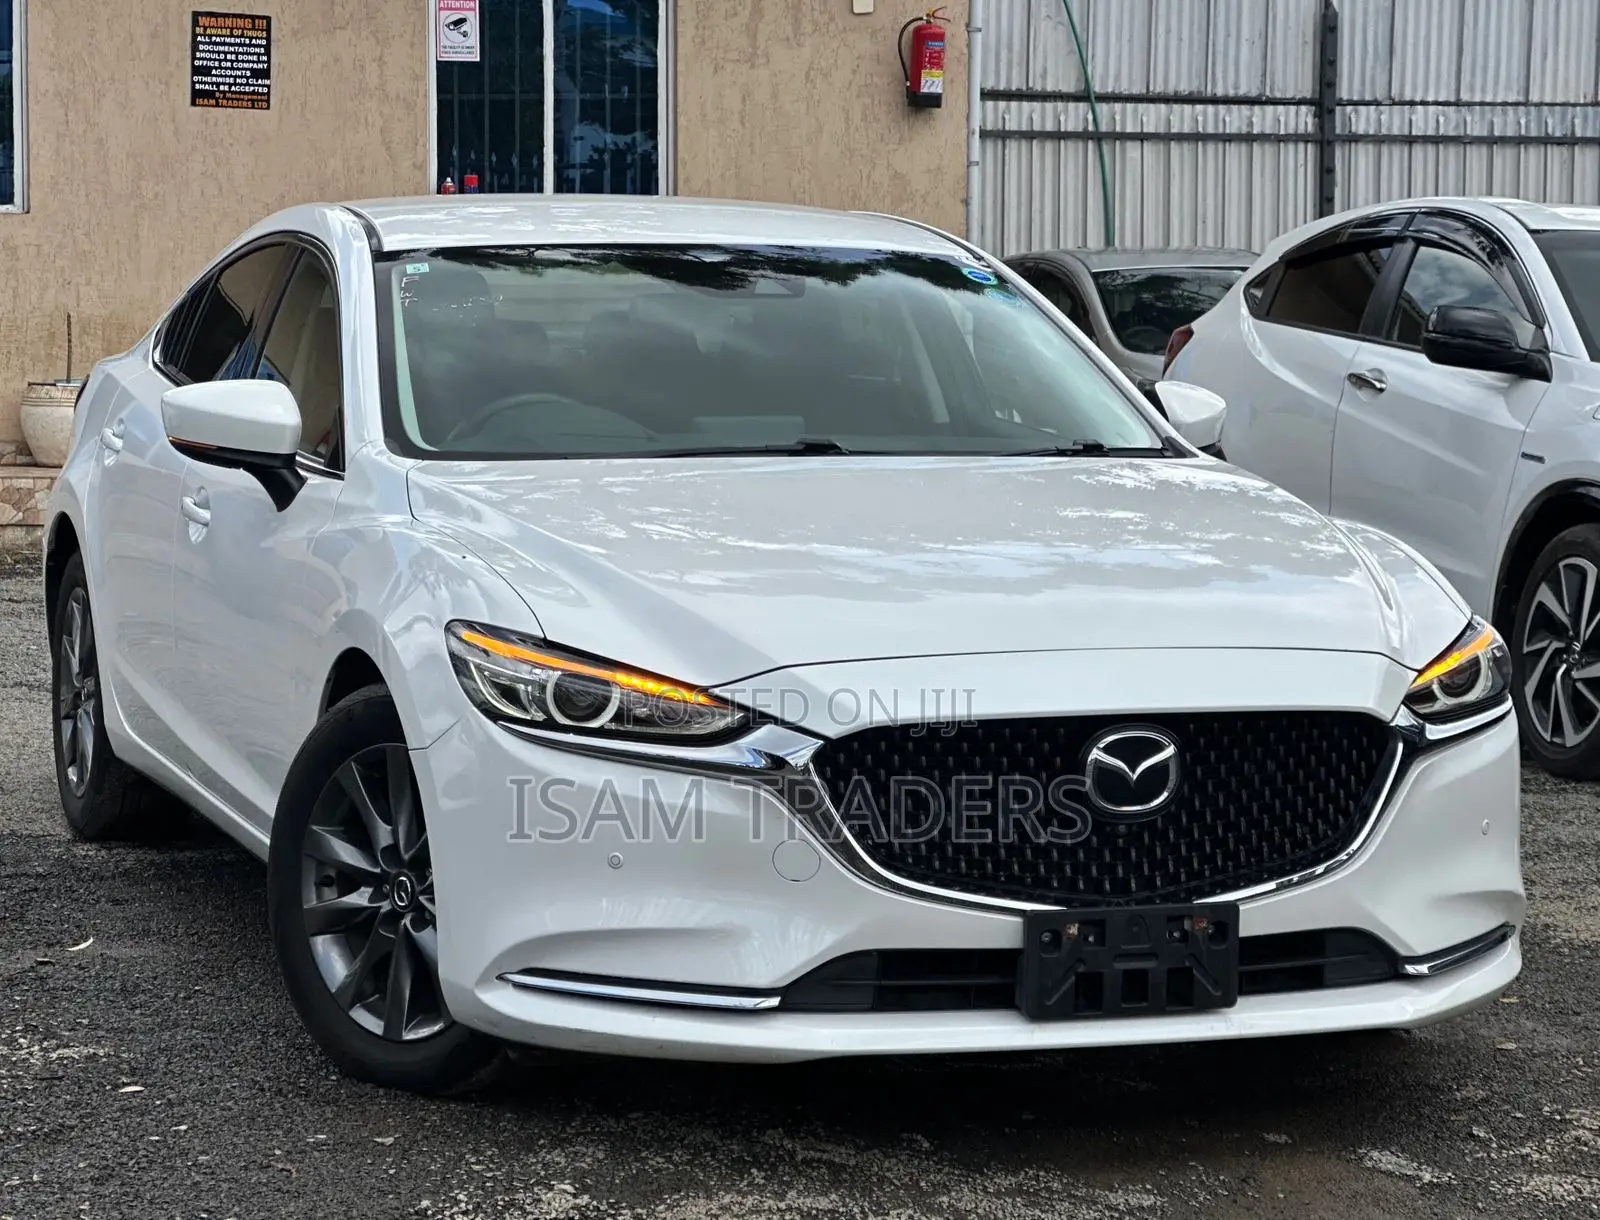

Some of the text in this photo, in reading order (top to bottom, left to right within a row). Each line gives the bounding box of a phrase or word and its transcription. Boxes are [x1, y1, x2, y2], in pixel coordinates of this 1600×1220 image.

[439, 0, 475, 8] ATTENTION
[199, 16, 266, 29] WARNING !!!
[199, 45, 264, 53] DOCUMENTATIONS
